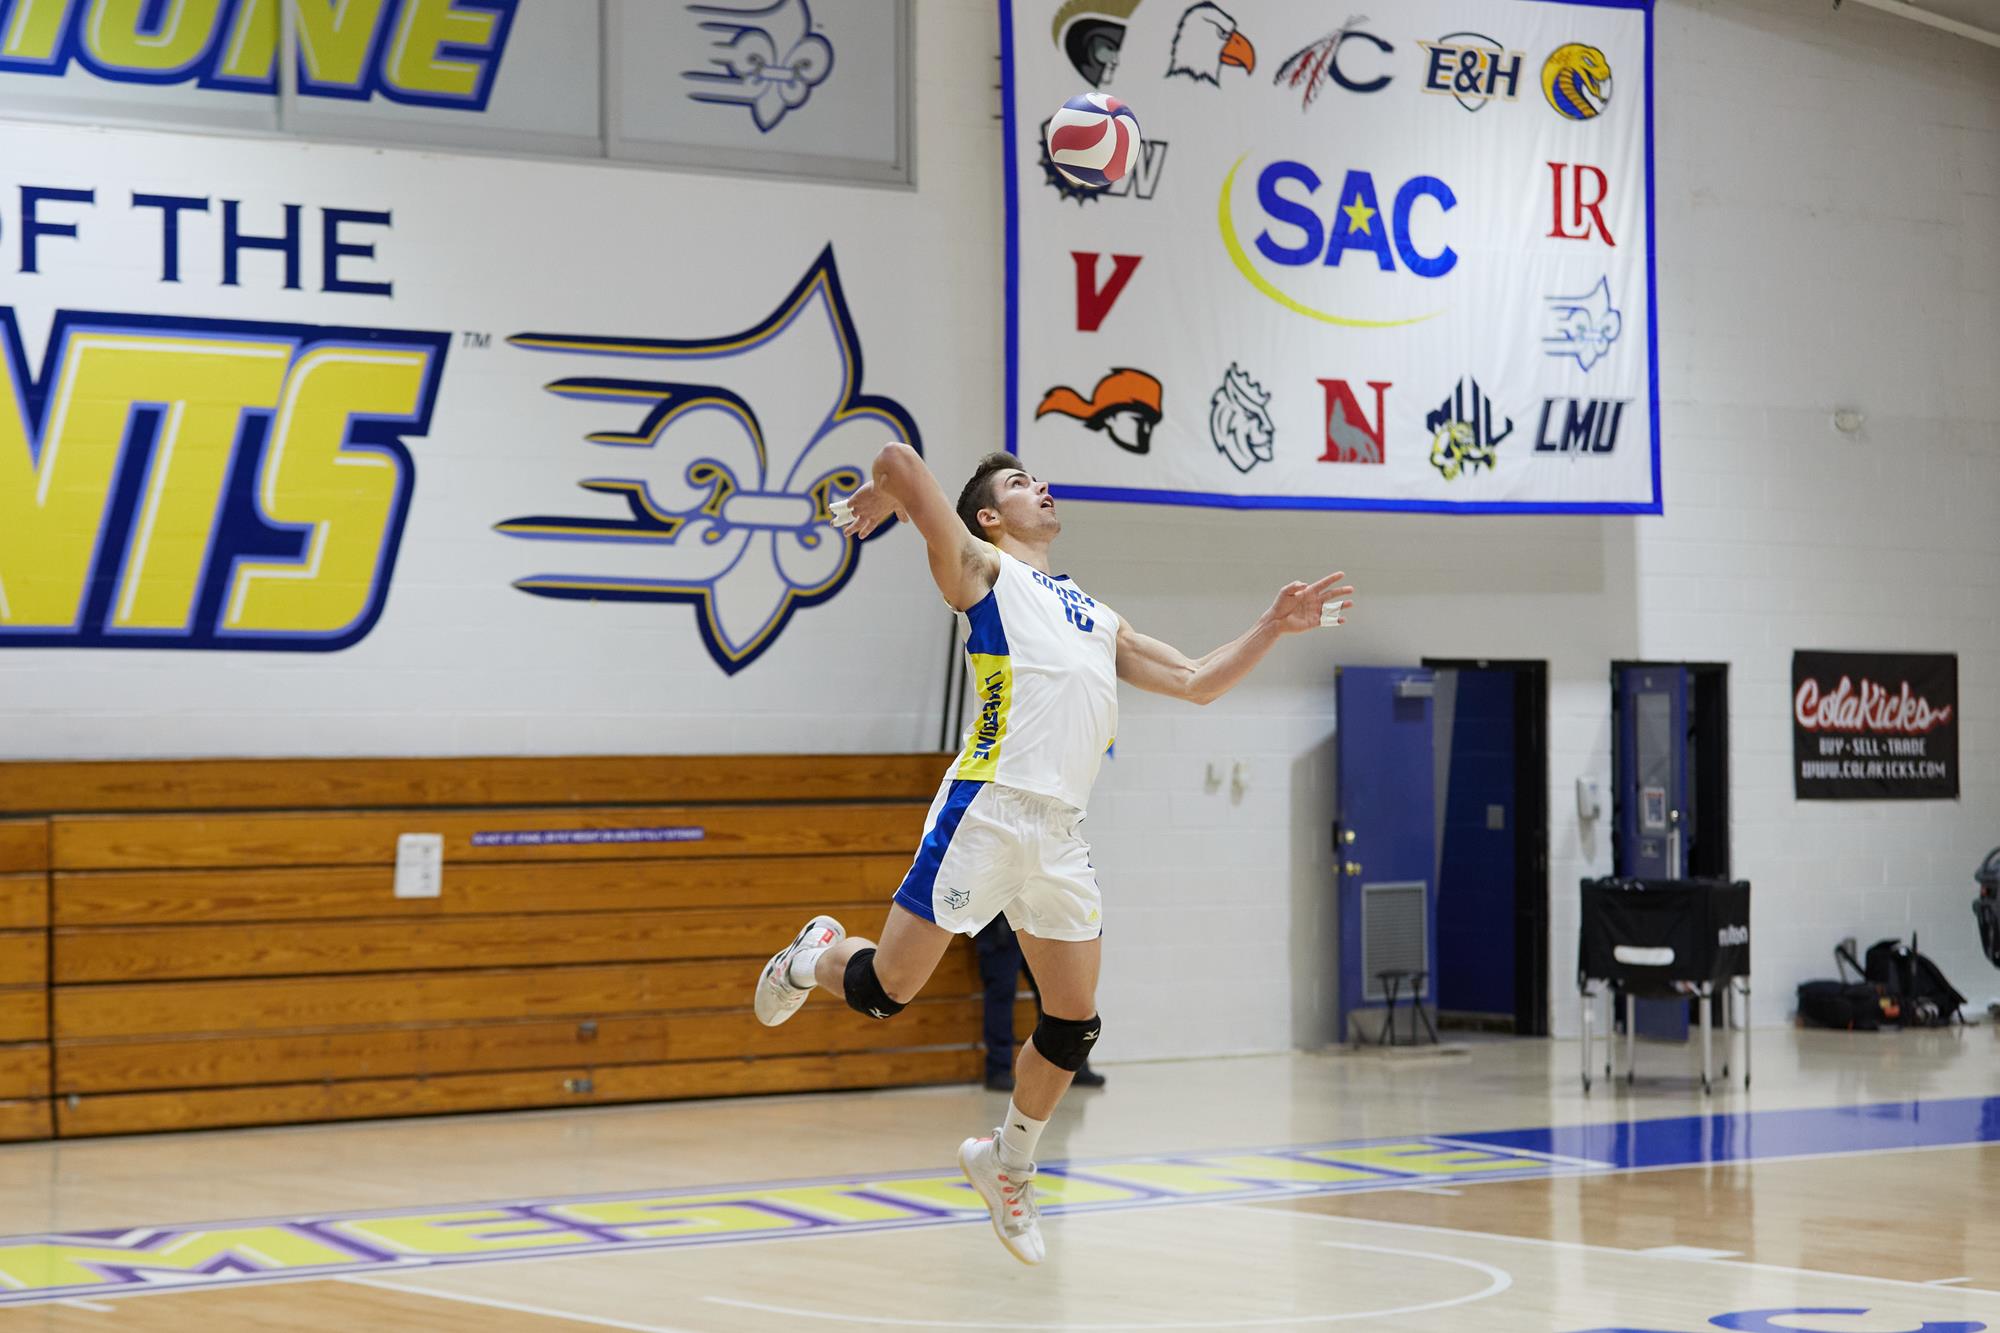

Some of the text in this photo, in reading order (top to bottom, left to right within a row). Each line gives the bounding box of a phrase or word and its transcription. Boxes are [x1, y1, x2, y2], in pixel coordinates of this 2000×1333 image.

[1425, 47, 1522, 99] E&H
[1255, 160, 1459, 279] SAC
[1545, 161, 1616, 248] LR
[0, 184, 394, 298] F THE
[1071, 251, 1143, 333] V
[1316, 378, 1393, 465] N
[1535, 398, 1627, 454] LMU
[1796, 675, 1952, 733] ColaKicks
[1801, 760, 1946, 780] WWW.COLAKICKS.COM
[1818, 737, 1927, 757] BUY SELL TRADE
